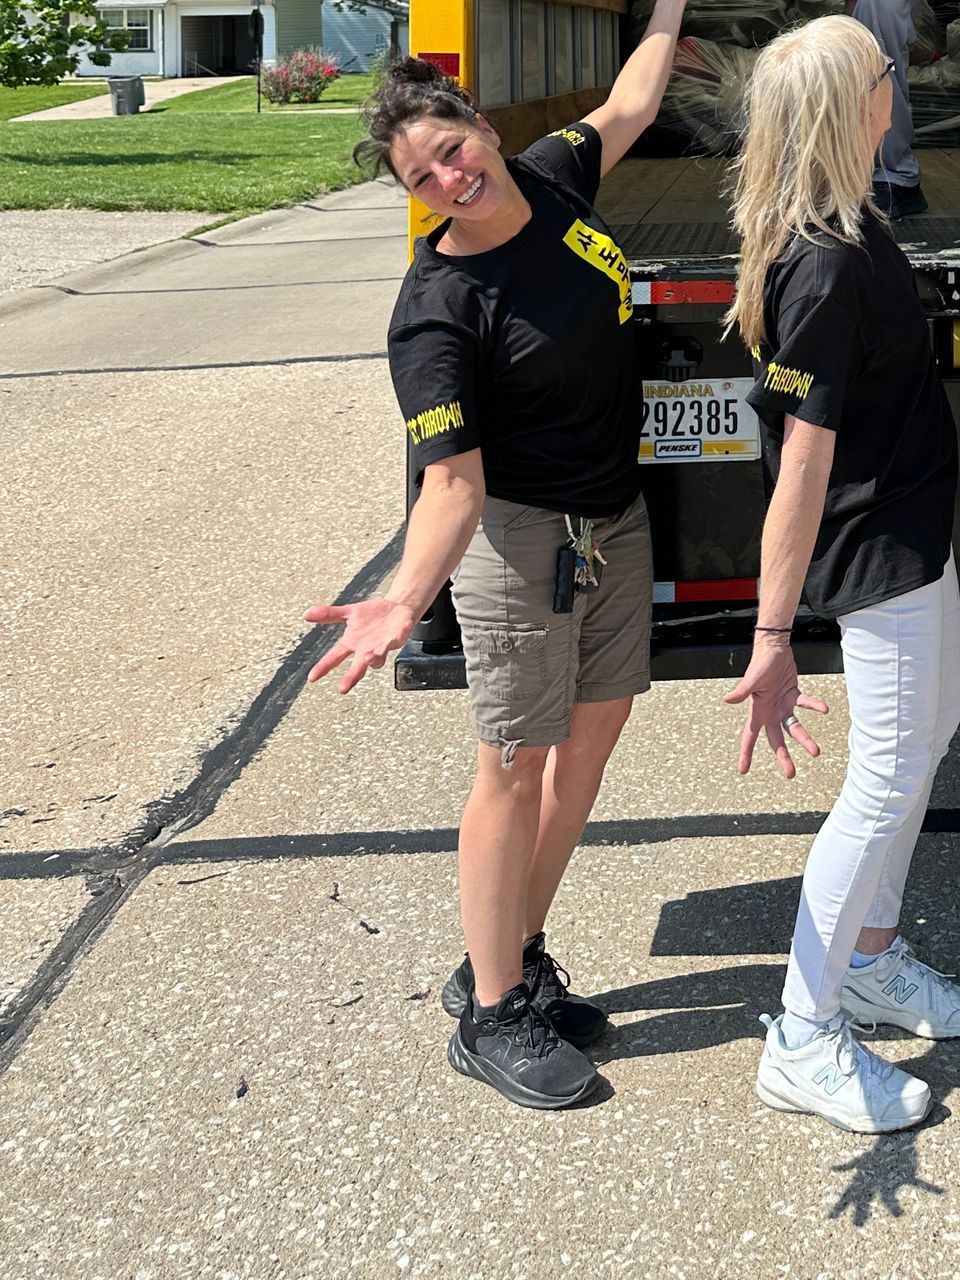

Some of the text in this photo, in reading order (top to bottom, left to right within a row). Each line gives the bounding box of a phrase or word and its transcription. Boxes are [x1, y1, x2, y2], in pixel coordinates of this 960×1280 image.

[644, 383, 714, 398] INDIANA
[417, 401, 464, 440] THROWN
[640, 399, 738, 438] 292385
[658, 444, 698, 452] PENSKE
